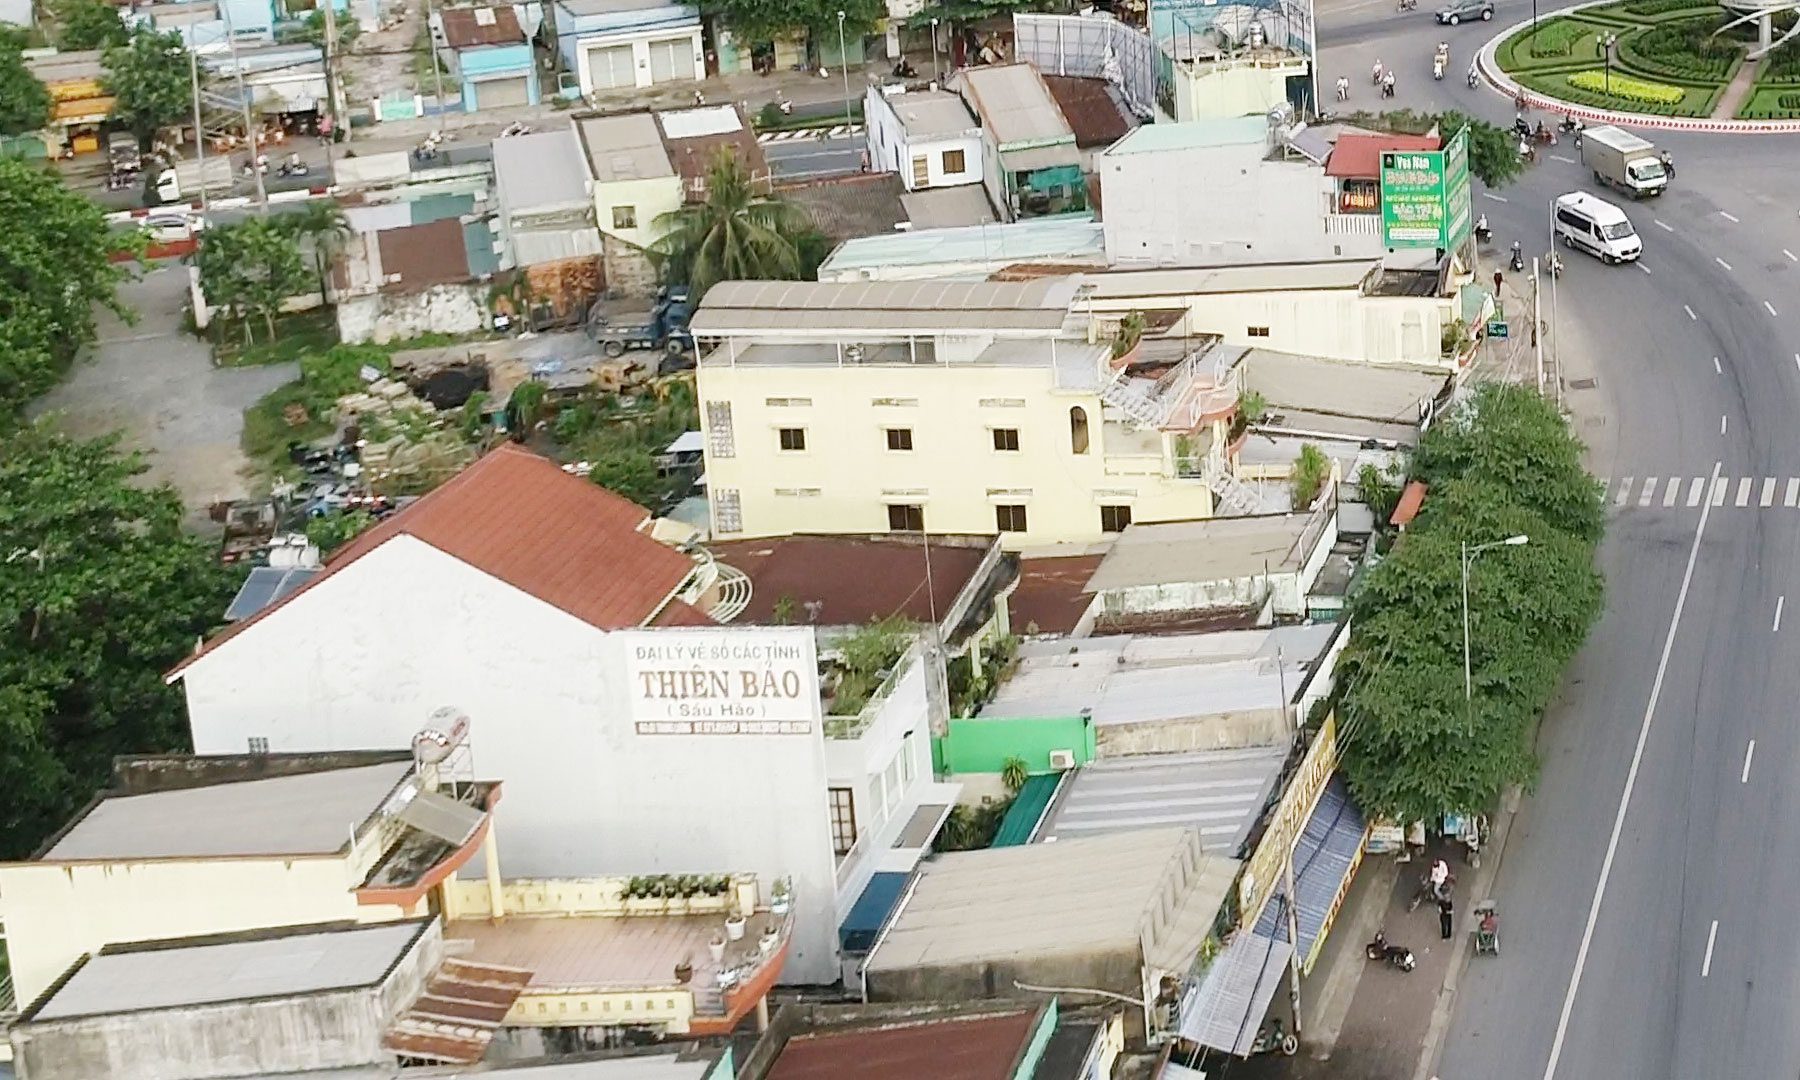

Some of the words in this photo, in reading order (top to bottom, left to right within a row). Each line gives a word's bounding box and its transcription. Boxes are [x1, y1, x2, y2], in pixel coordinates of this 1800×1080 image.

[636, 646, 662, 664] ĐẠI
[666, 642, 683, 660] LÝ
[733, 641, 762, 659] CÁC
[638, 664, 730, 699] THIÊN
